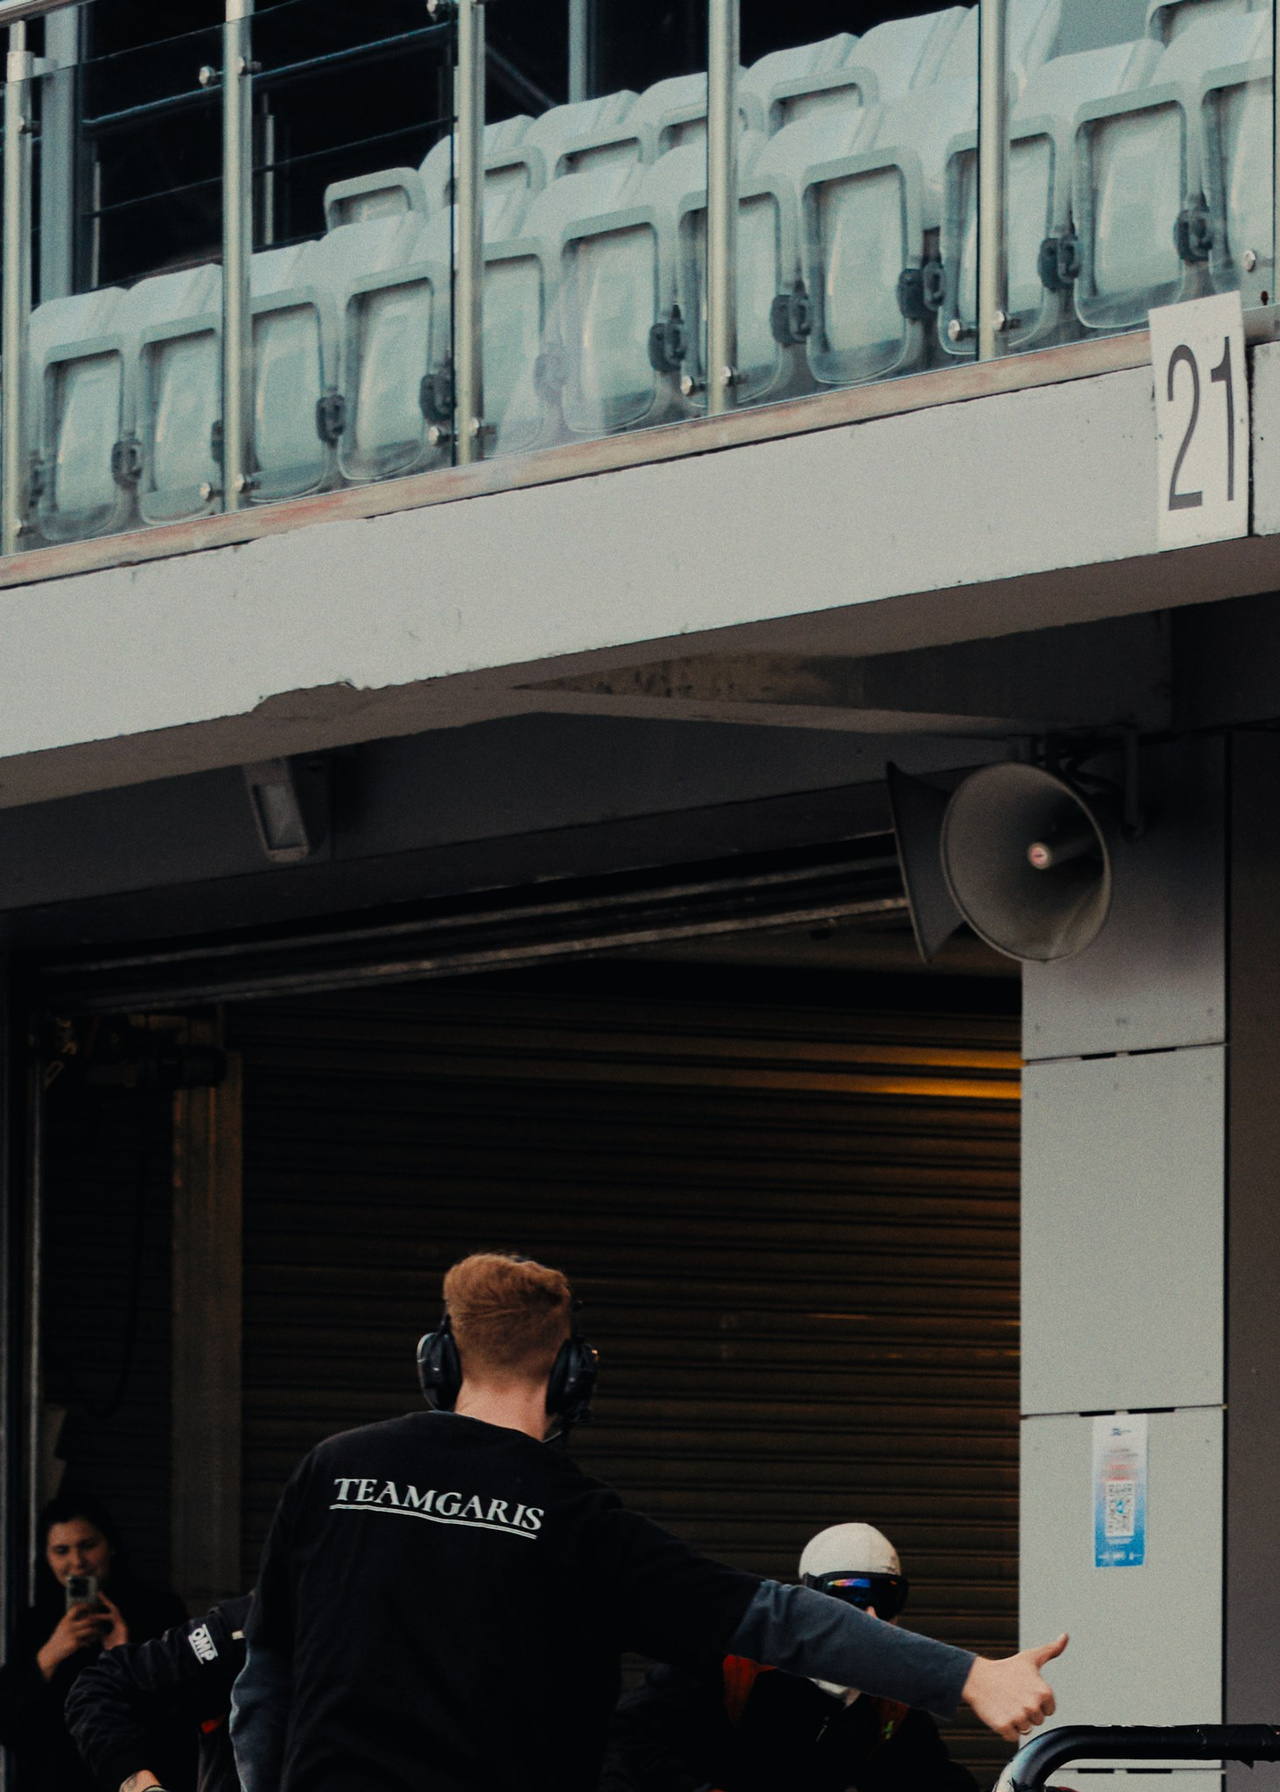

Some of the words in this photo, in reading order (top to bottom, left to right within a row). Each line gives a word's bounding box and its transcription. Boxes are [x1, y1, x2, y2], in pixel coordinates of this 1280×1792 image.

[1167, 335, 1236, 512] 21
[333, 1477, 545, 1531] TEAMGARIS
[192, 1627, 216, 1661] OMP
